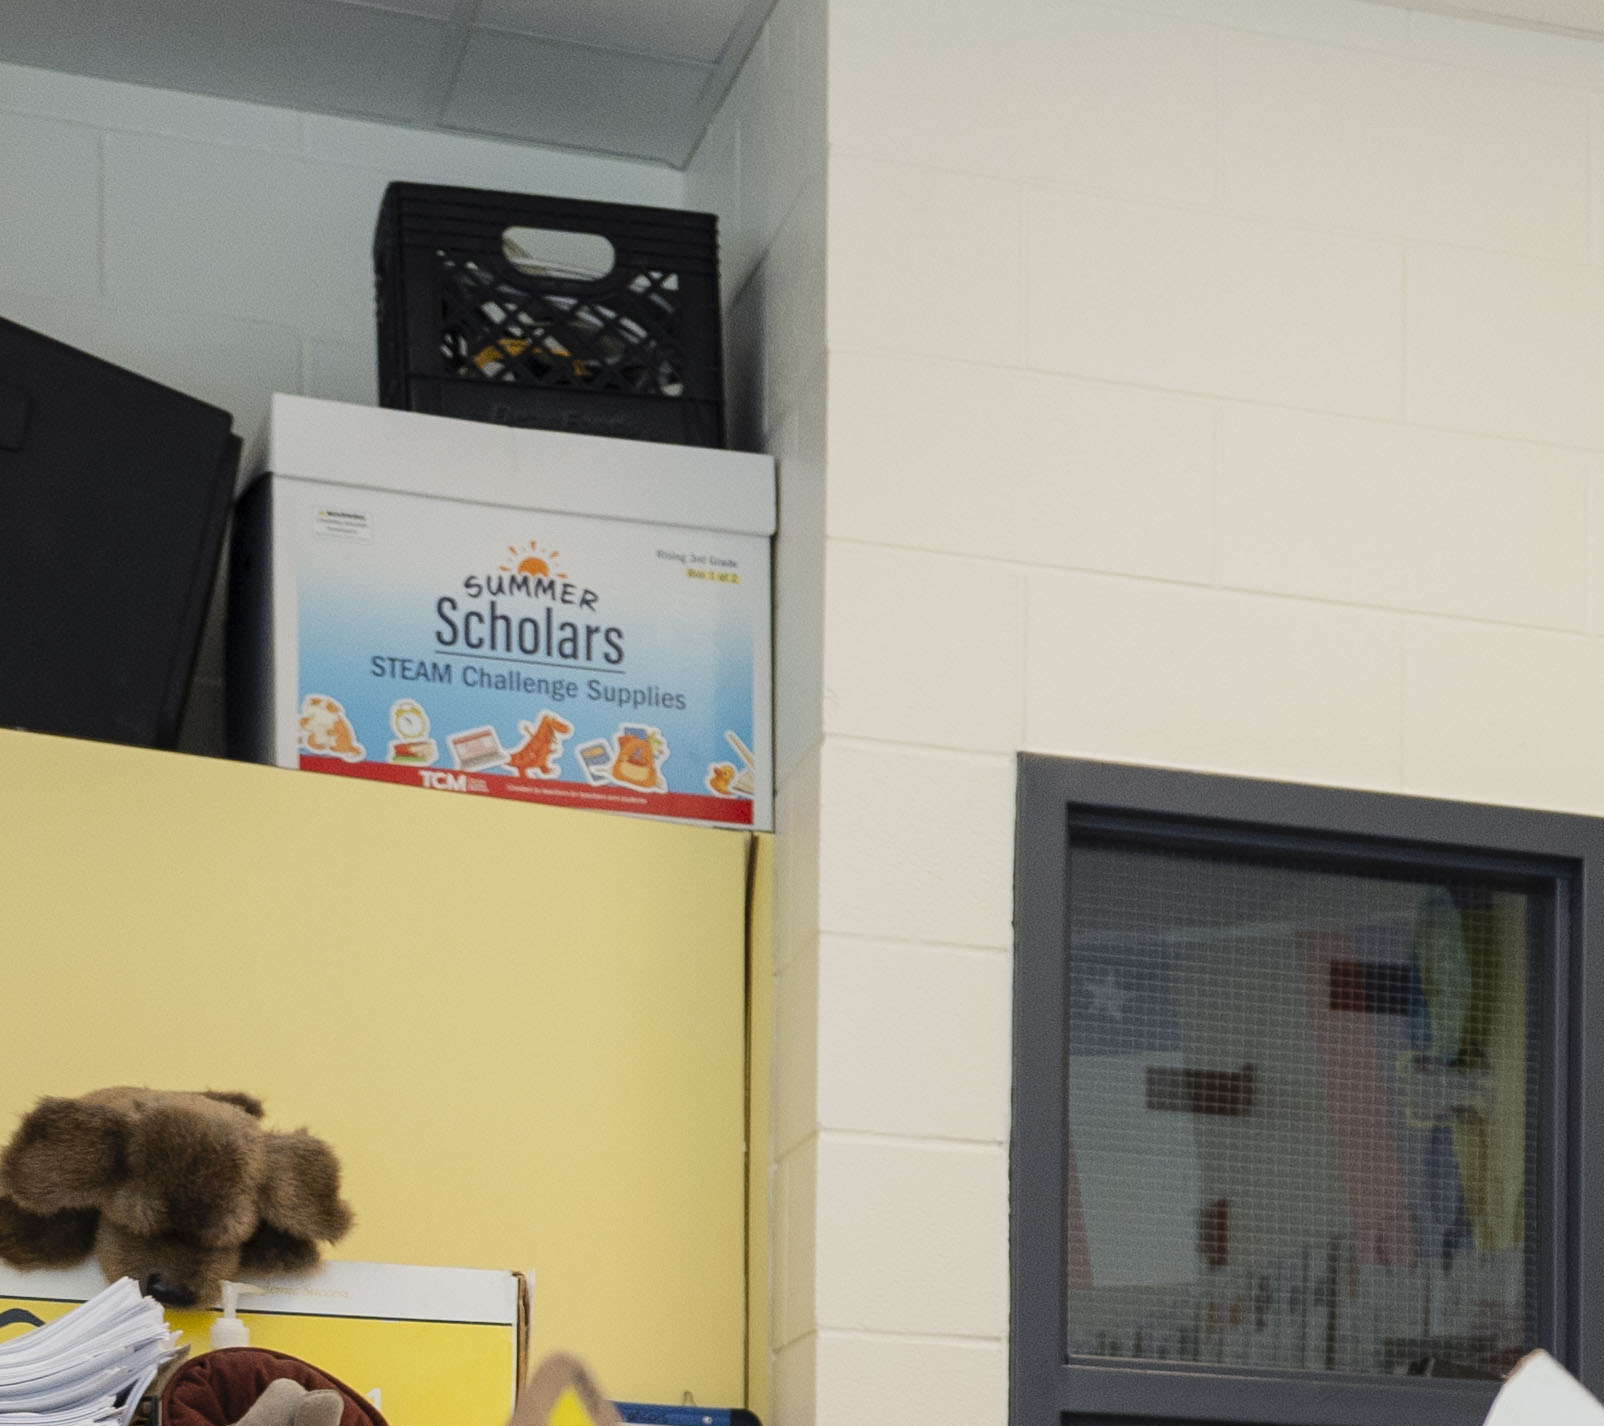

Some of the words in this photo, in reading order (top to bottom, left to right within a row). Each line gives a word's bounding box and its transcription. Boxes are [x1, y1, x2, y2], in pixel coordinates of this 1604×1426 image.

[463, 573, 599, 612] SUMMER
[435, 597, 624, 665] Scholars
[371, 655, 453, 685] STEAM
[462, 665, 579, 702] Challenge
[587, 679, 687, 711] Supplies
[419, 770, 467, 792] TCM
